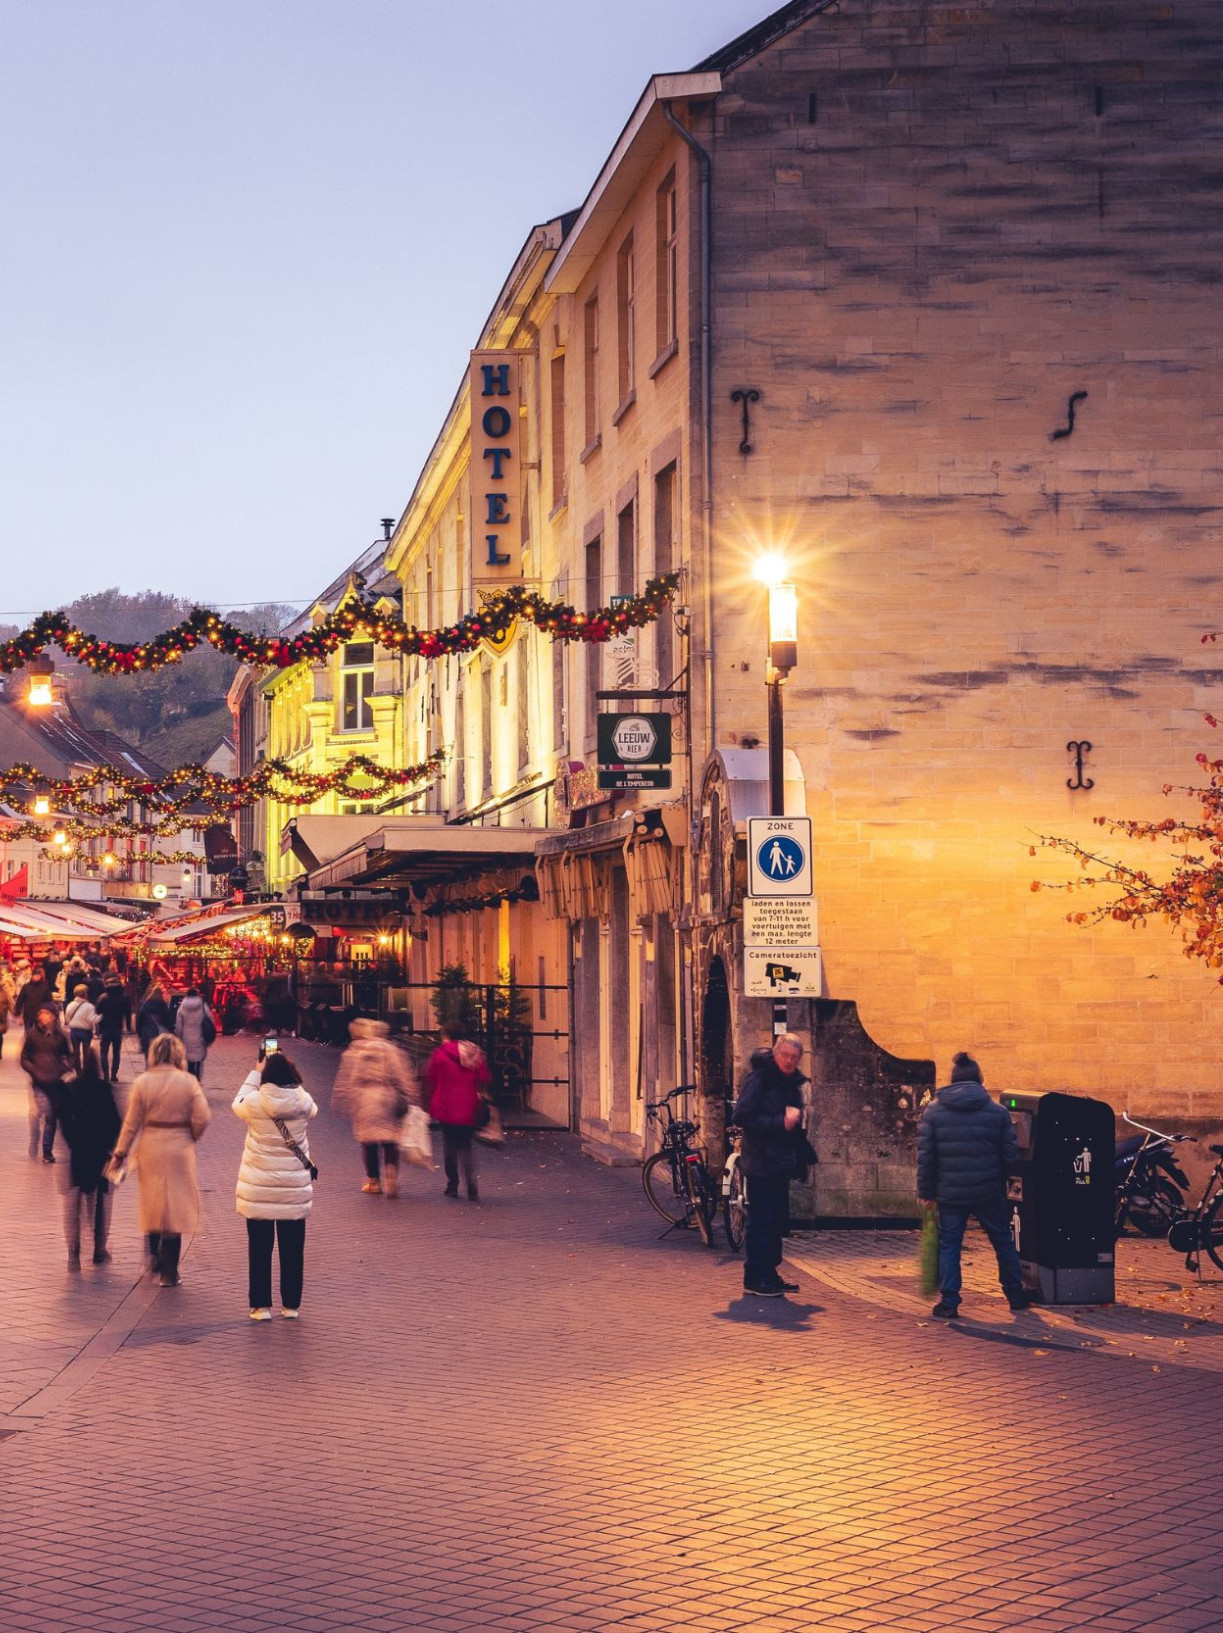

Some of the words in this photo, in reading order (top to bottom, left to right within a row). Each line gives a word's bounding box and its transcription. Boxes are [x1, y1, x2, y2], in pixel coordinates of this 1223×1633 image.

[481, 364, 511, 566] HOTEL
[618, 733, 651, 743] LEEUW
[627, 745, 642, 753] BIER
[767, 822, 794, 830] ZONE
[270, 911, 284, 923] 35
[787, 930, 812, 938] lengte
